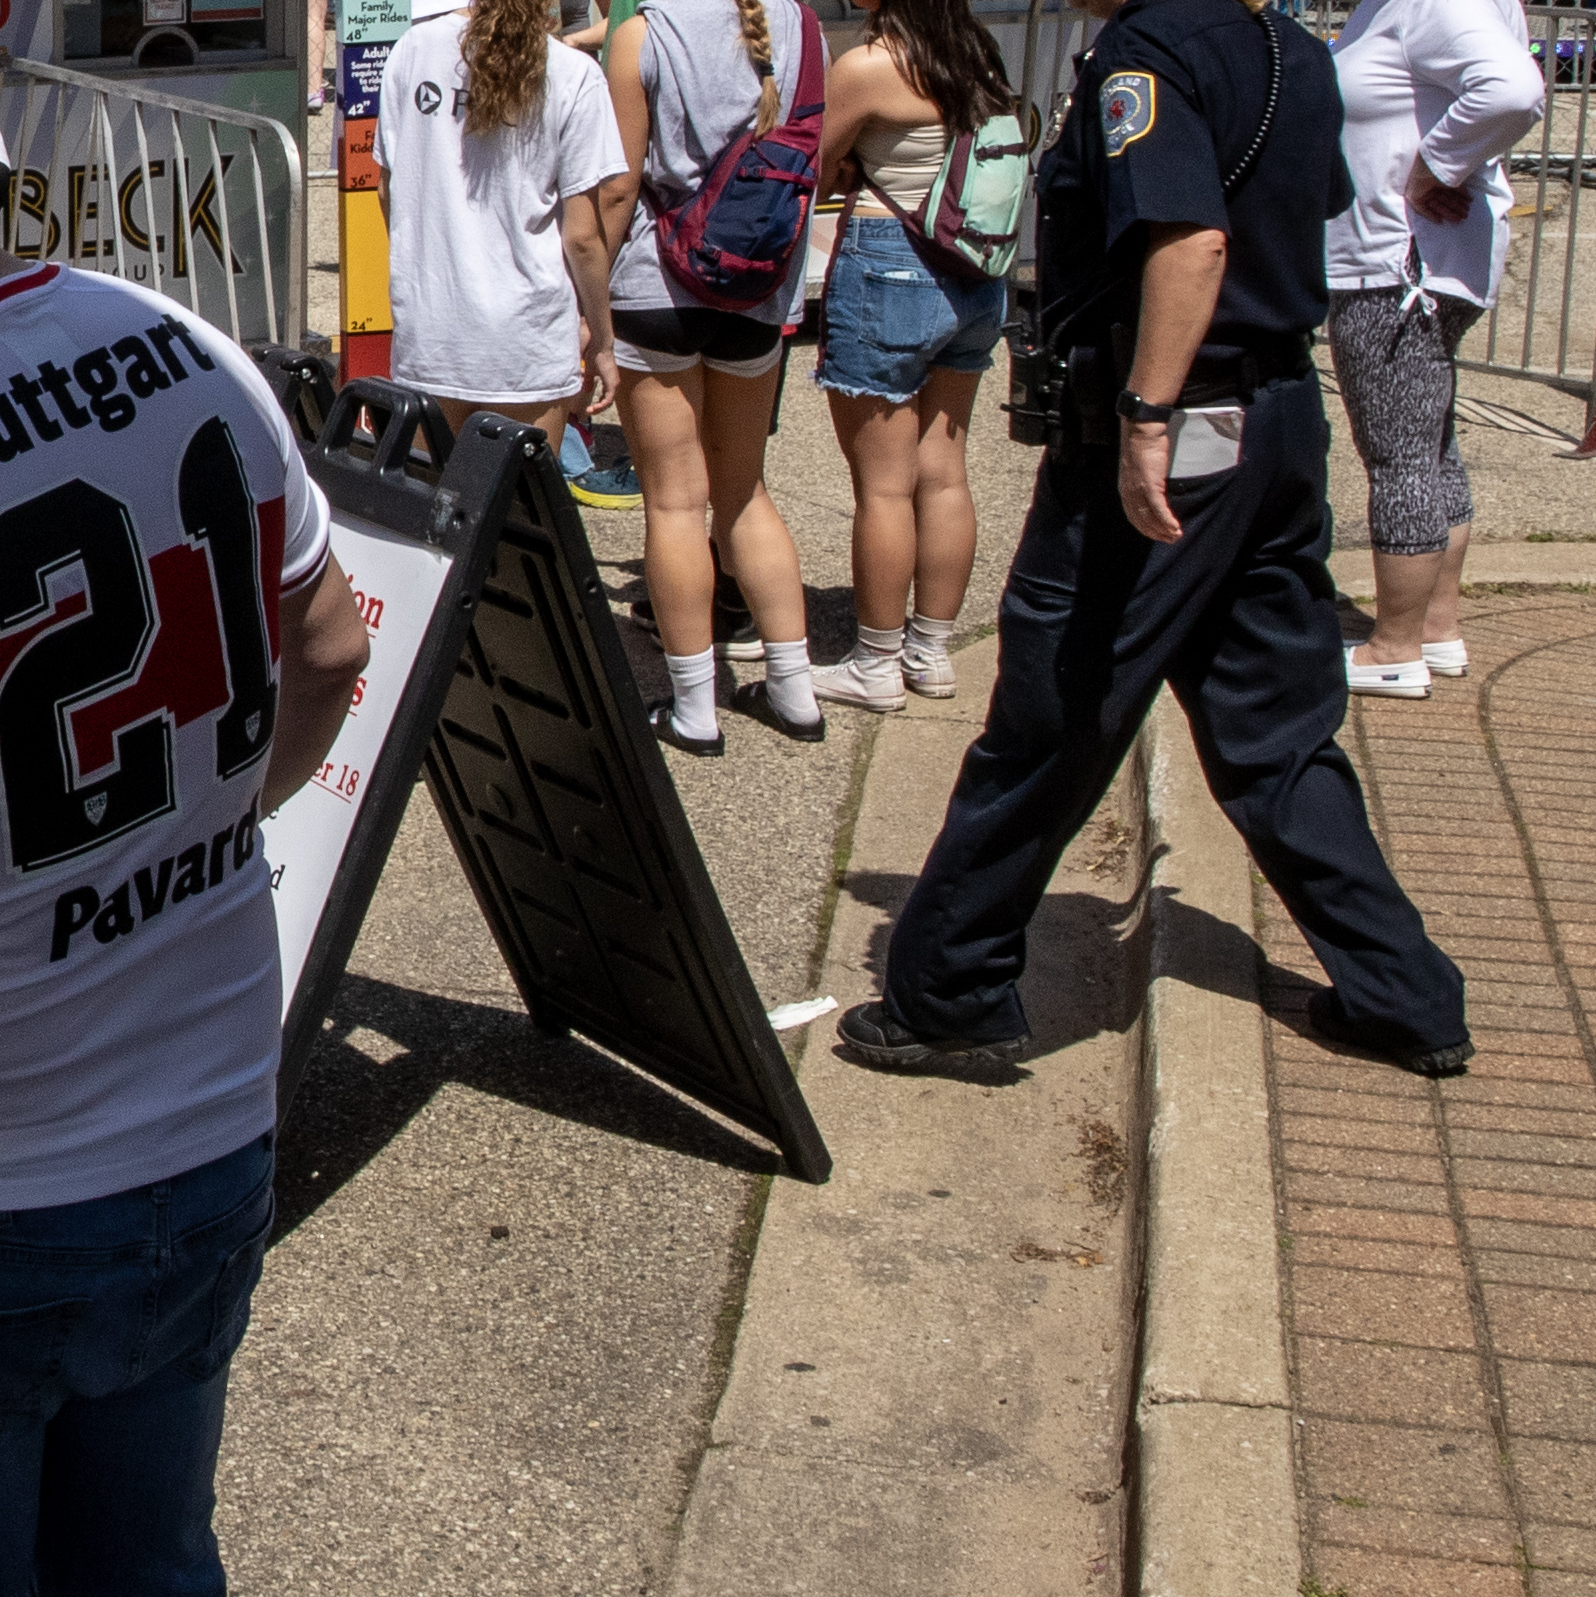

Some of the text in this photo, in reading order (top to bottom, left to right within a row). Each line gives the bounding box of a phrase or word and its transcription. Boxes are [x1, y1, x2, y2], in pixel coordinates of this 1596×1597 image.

[360, 0, 395, 16] Family
[347, 12, 409, 27] Major Rides
[351, 61, 372, 70] Some
[351, 69, 378, 79] require
[361, 84, 380, 94] their
[3, 155, 245, 279] BECK
[336, 765, 360, 797] 18
[49, 807, 263, 963] Pavard
